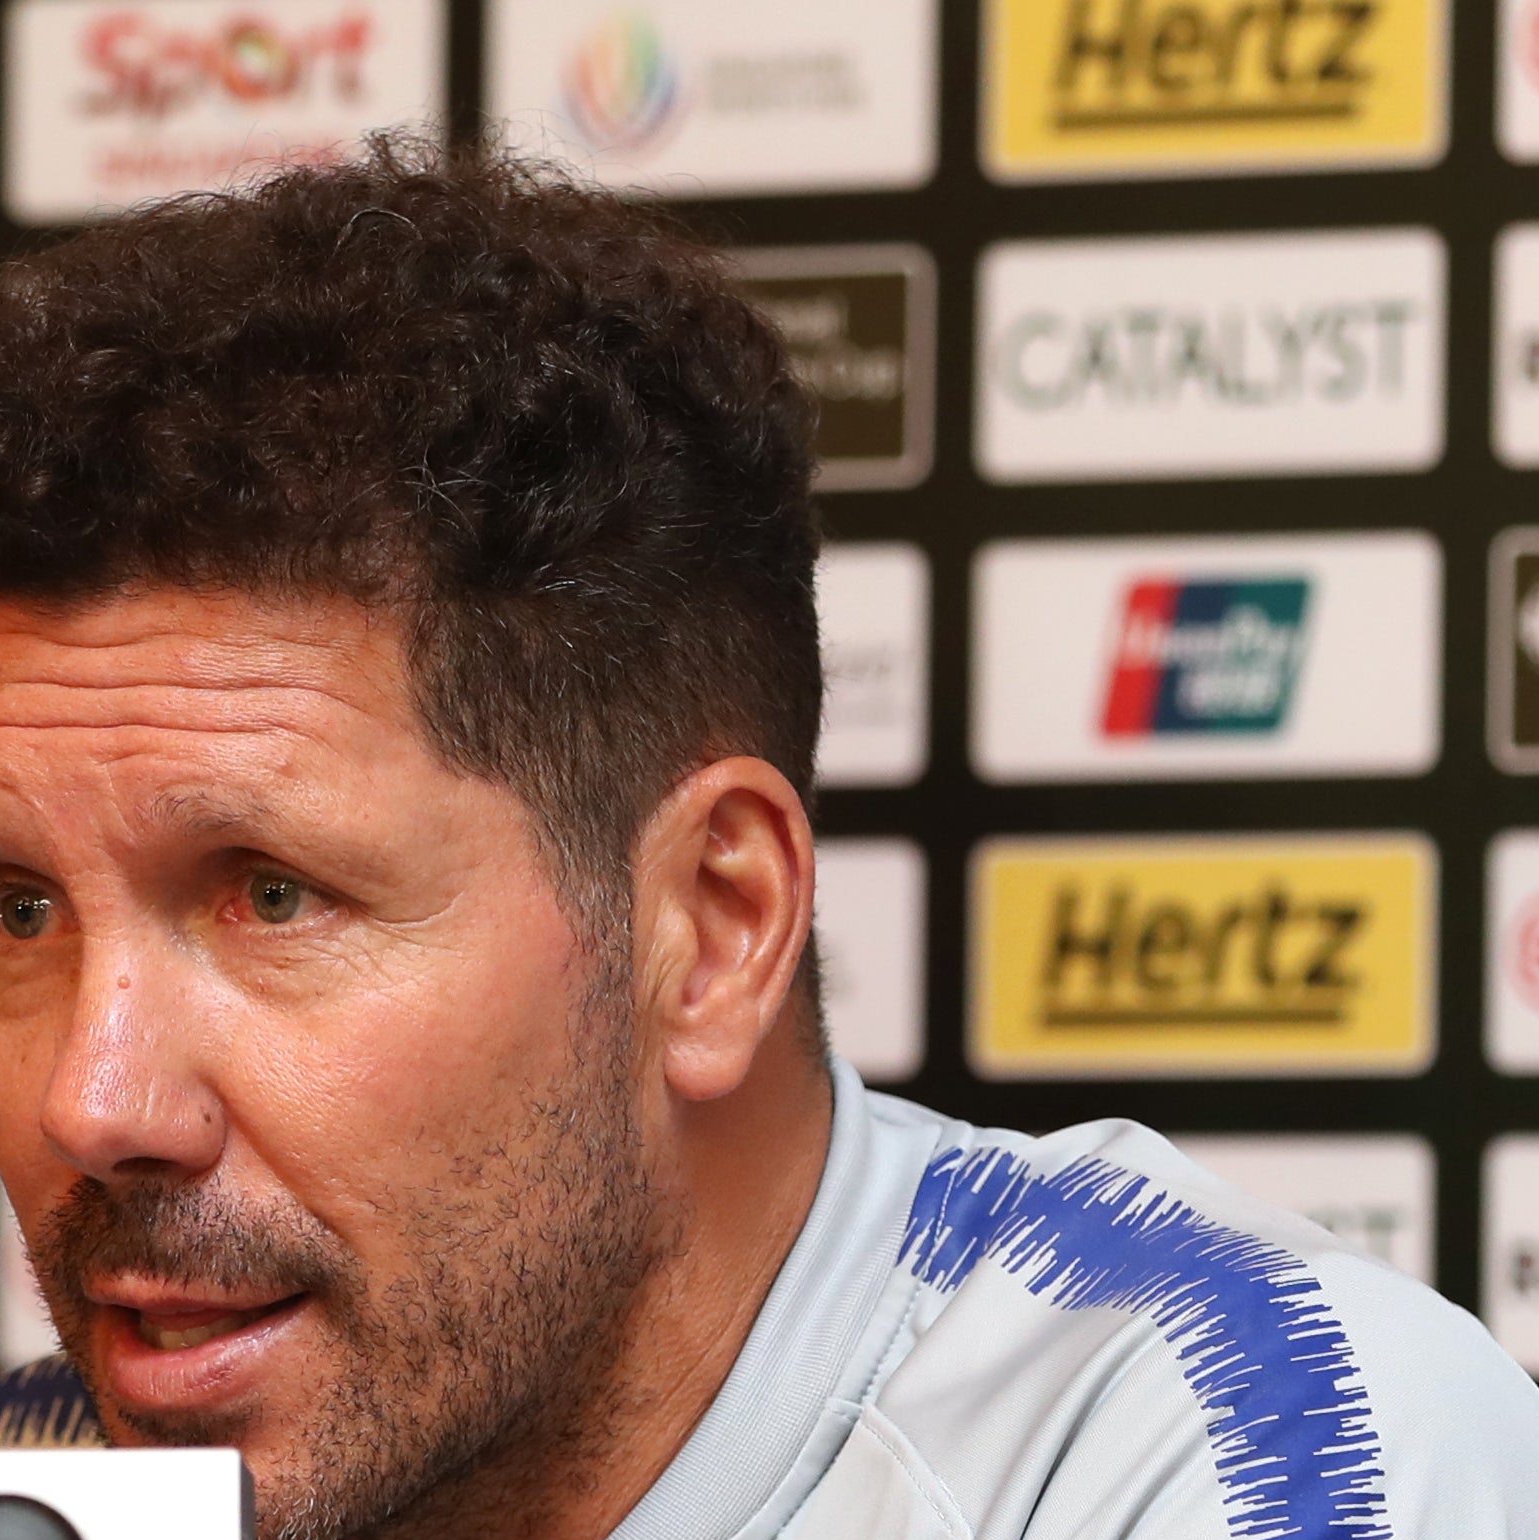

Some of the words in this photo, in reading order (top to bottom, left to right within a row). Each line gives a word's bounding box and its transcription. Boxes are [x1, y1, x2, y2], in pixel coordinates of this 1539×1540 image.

[1054, 0, 1379, 93] Hertz
[1003, 300, 1418, 412] CATALYST
[1042, 884, 1368, 992] Hertz
